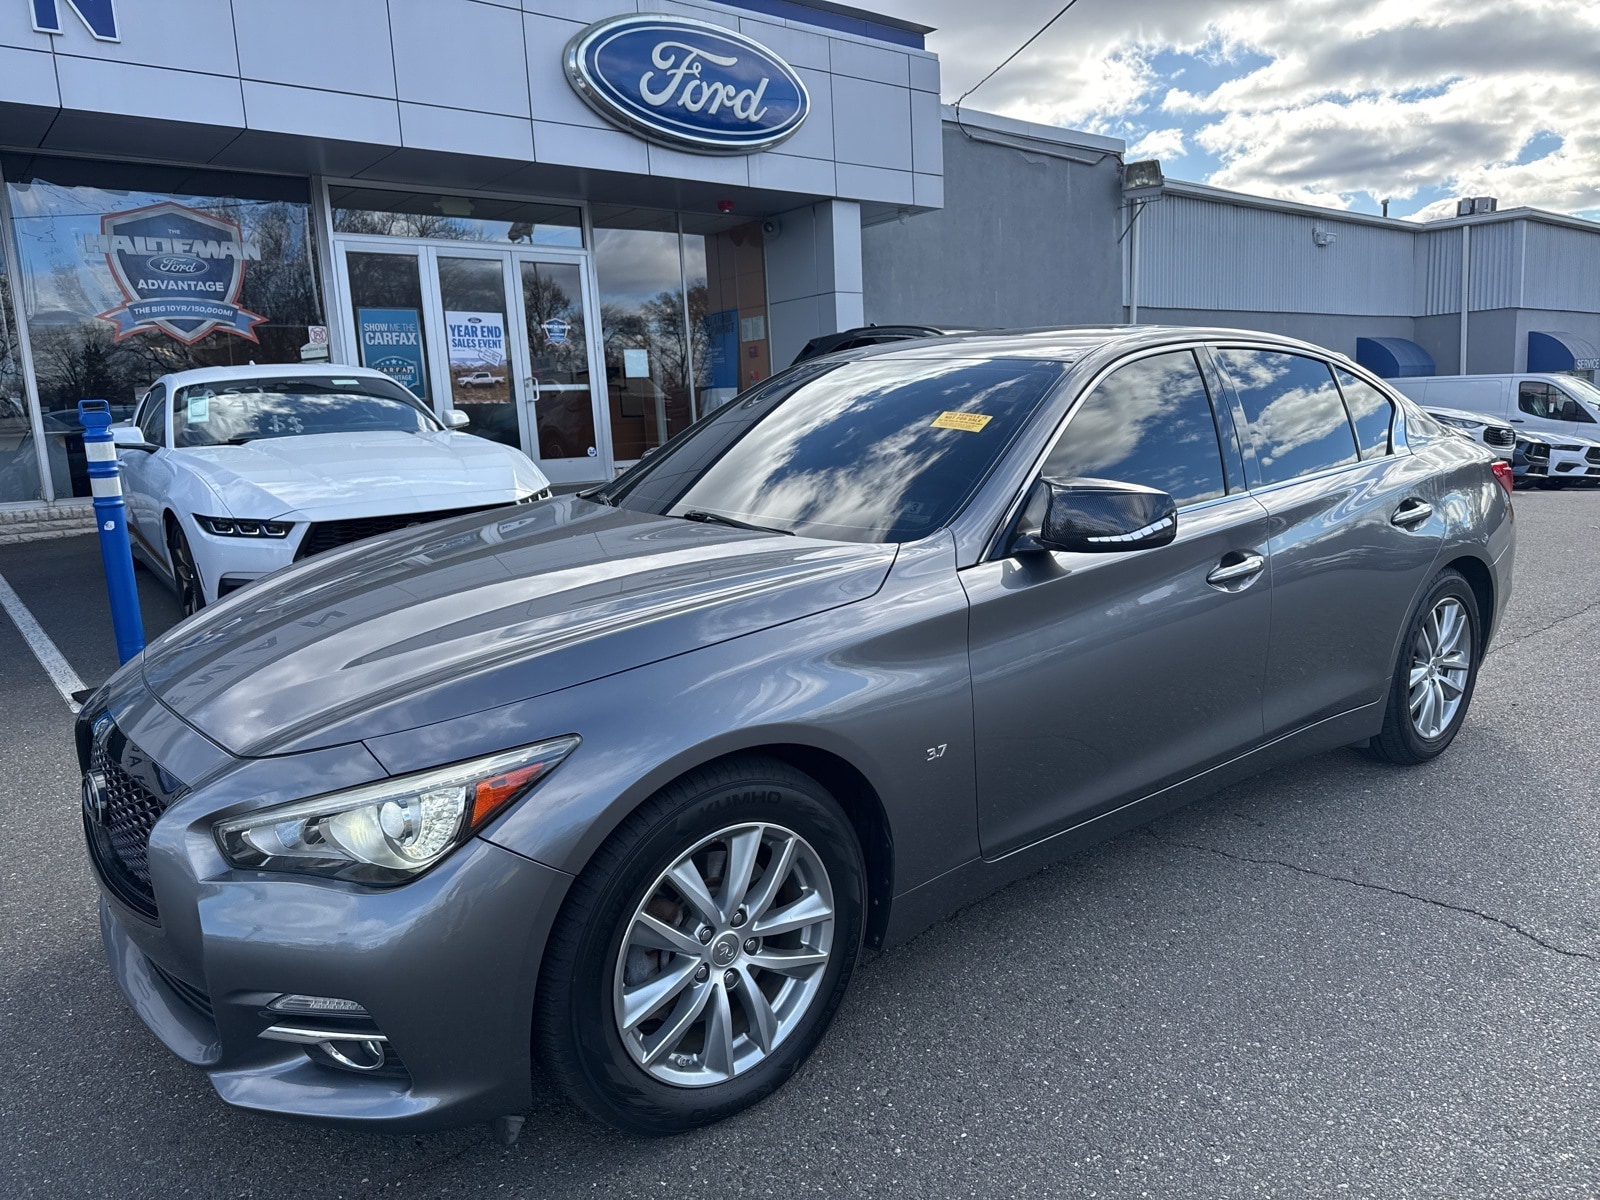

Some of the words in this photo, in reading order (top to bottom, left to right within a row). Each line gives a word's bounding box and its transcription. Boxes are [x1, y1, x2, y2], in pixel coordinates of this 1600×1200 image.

[639, 41, 769, 123] Ford
[84, 235, 262, 261] HALDEMAN
[160, 258, 197, 273] Ford
[137, 279, 225, 292] ADVANTAGE
[133, 307, 150, 315] THE
[151, 305, 166, 313] BIG
[166, 305, 233, 317] 10YR/150,000MI
[363, 322, 388, 332] SHOW
[389, 323, 401, 332] ME
[402, 323, 416, 332] THE
[449, 324, 478, 338] YEAR
[481, 325, 502, 338] END
[365, 332, 417, 345] CARFAX
[452, 338, 477, 348] SALES
[478, 339, 502, 349] EVENT
[1576, 358, 1600, 370] SERVICE
[926, 743, 948, 762] 3.7
[699, 790, 782, 812] KUMHO
